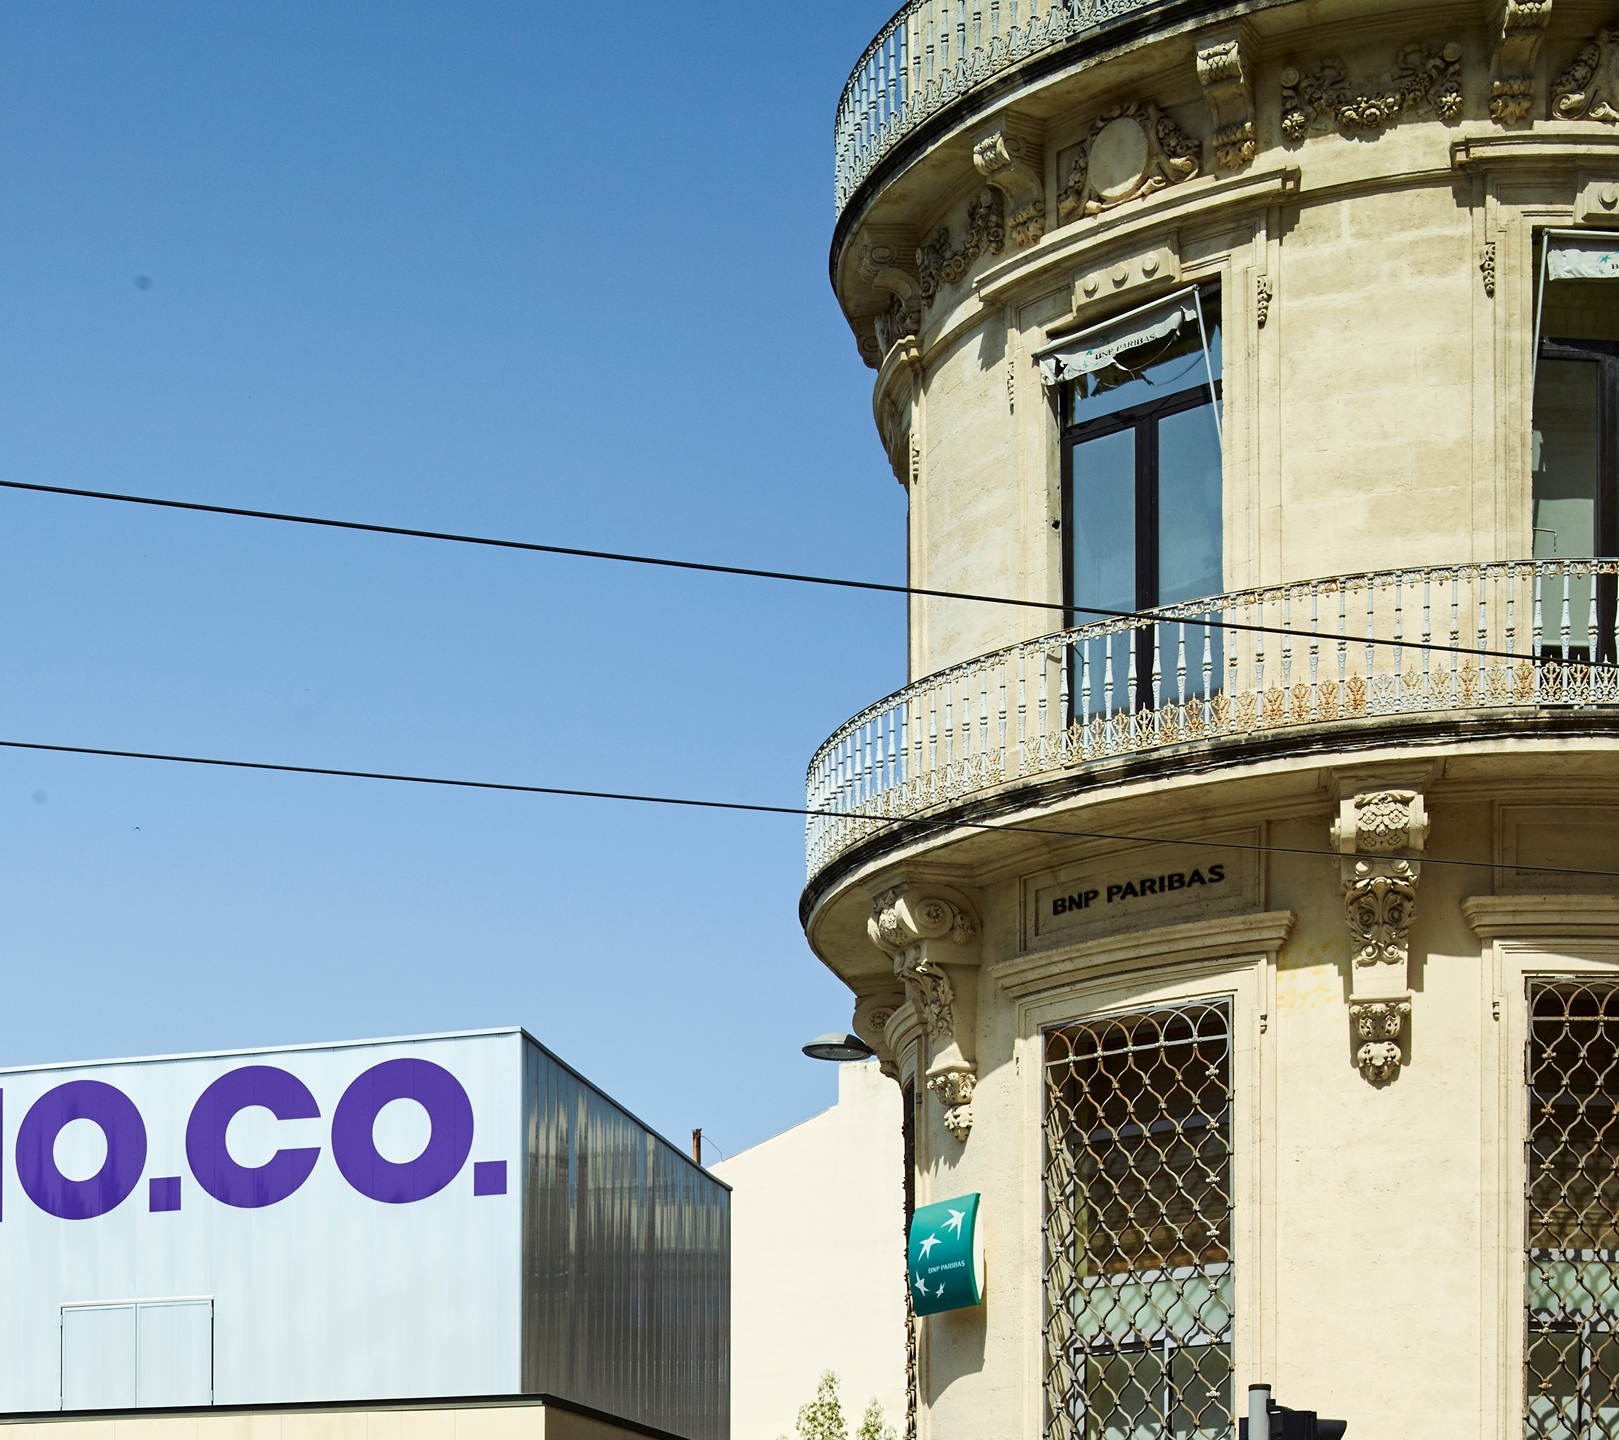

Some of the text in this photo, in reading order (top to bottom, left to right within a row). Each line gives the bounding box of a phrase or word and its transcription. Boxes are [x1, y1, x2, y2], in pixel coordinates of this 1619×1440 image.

[1052, 864, 1225, 916] BNP PARIBAS
[928, 1260, 965, 1274] BNP PARIBAS
